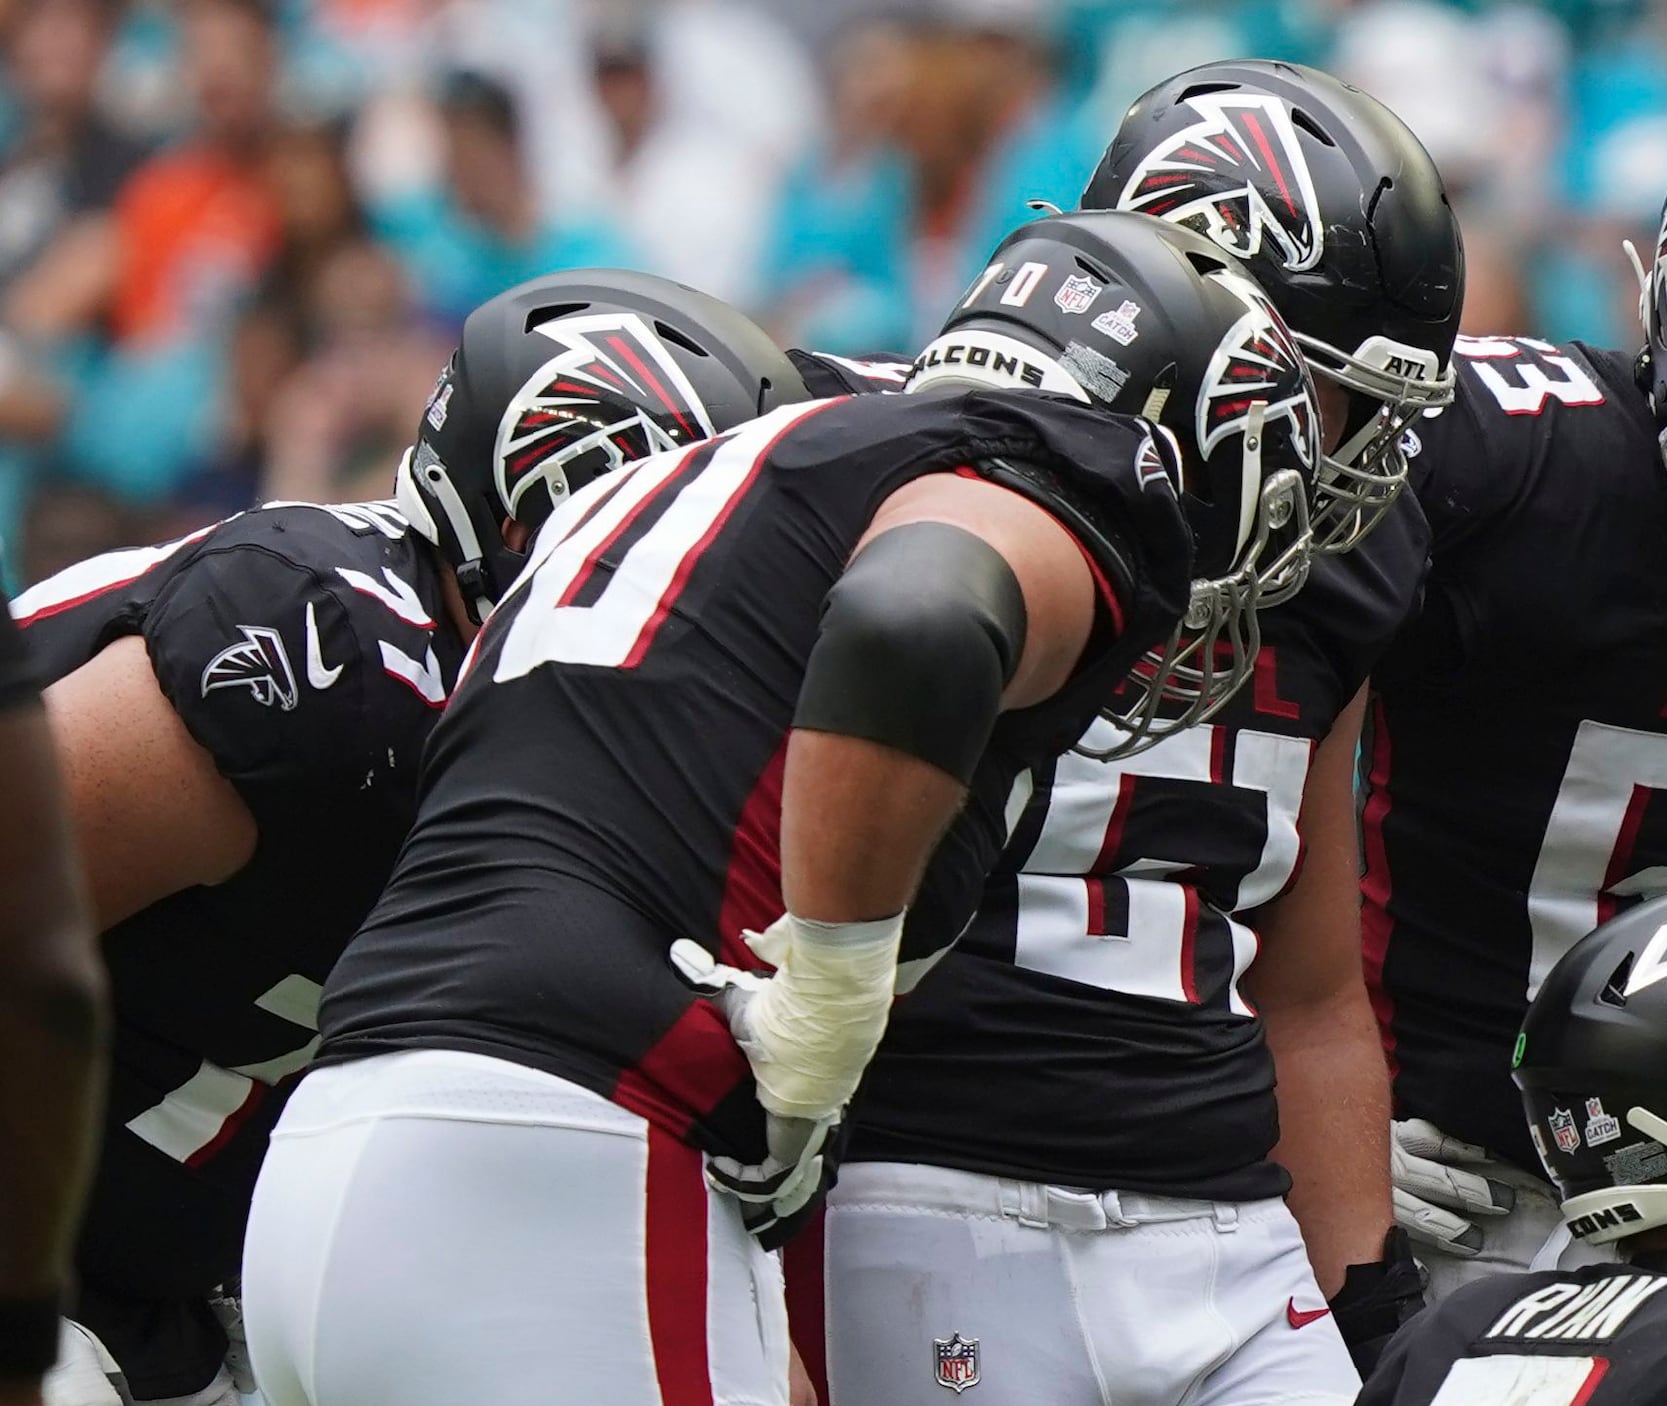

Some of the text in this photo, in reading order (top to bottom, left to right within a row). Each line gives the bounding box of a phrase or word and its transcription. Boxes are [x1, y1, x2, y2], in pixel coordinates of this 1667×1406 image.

[1061, 289, 1087, 309] NFL
[903, 344, 1045, 389] ALCONS
[1382, 355, 1427, 381] ATL
[1557, 1128, 1577, 1148] NFL
[1587, 1120, 1618, 1140] CATCH
[942, 1359, 974, 1381] NFL
